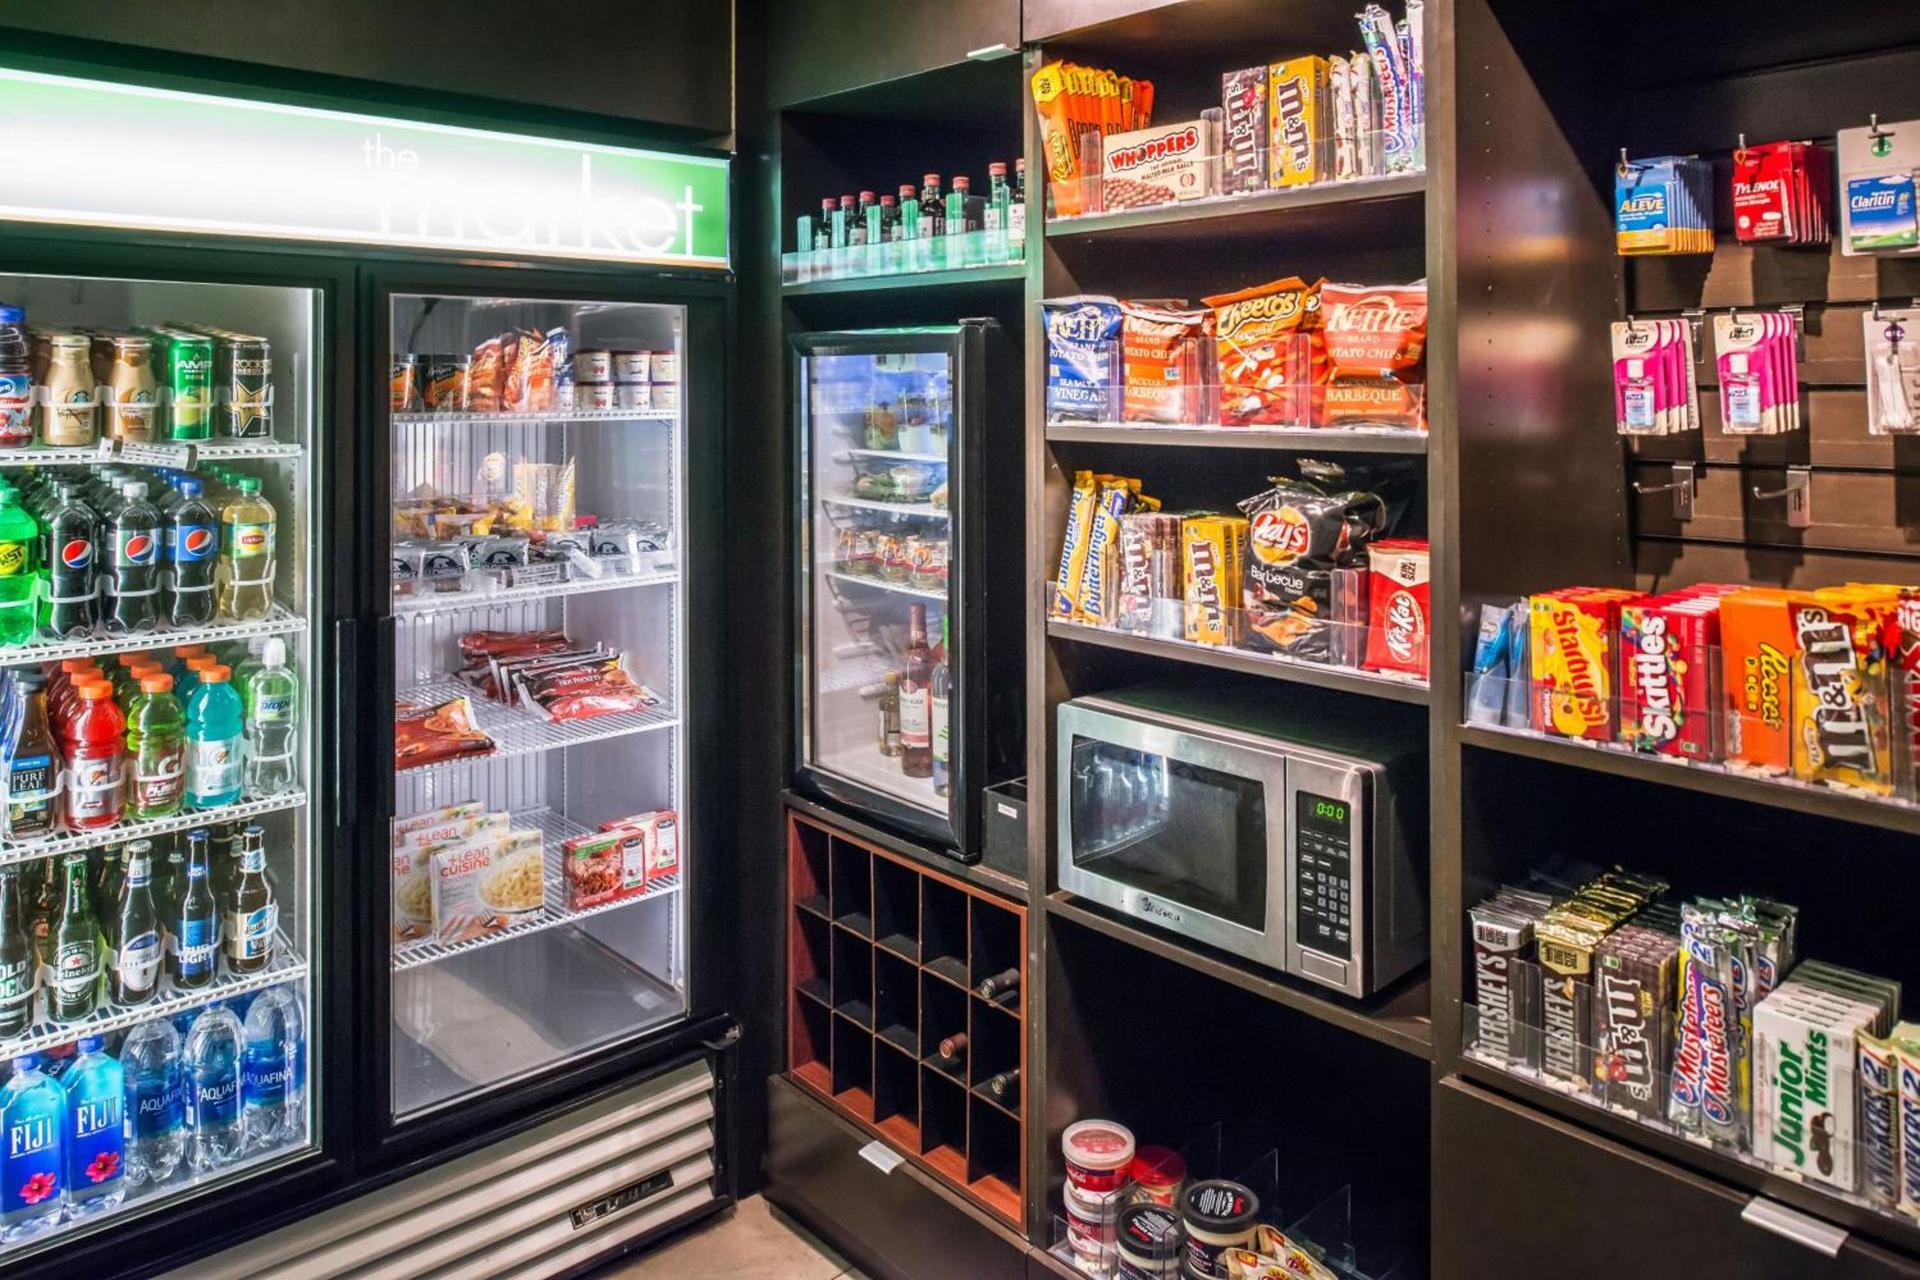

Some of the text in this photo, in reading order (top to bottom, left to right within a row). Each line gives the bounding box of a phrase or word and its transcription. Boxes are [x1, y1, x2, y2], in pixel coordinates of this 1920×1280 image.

[1227, 81, 1257, 174] m&m's
[1278, 76, 1310, 172] m&m's
[363, 133, 418, 170] the
[1111, 131, 1196, 169] WHOPPERS
[378, 153, 703, 258] market
[1620, 200, 1664, 212] ALEVE
[1735, 180, 1781, 195] TYLENOL
[1852, 194, 1895, 208] Claritin
[1217, 291, 1298, 336] Cheetos
[177, 361, 212, 369] AMP
[1367, 348, 1402, 361] CHIPS
[1056, 387, 1108, 402] VINEGAR
[1327, 388, 1402, 404] BARBEQUE
[1058, 490, 1083, 588] Butterfinger
[1085, 512, 1107, 616] Butterfinger
[1251, 565, 1304, 590] Barbecue
[1191, 541, 1221, 632] m&m's
[1636, 616, 1677, 740] Skittles
[1760, 643, 1788, 731] Reese's
[1800, 609, 1877, 773] m&m's
[12, 771, 46, 784] PURE
[13, 781, 42, 792] LEAF
[1316, 802, 1345, 820] 0:00
[425, 827, 457, 846] Lean
[457, 846, 491, 863] Lean
[439, 857, 491, 878] cuisine
[1478, 951, 1509, 1060] HERSHEY'S
[1543, 977, 1574, 1073] HERSHEY'S
[1605, 977, 1648, 1100] m&m's
[1703, 984, 1731, 1102] Musketeers
[1804, 1030, 1828, 1107] Mints
[76, 1097, 118, 1134] FIJI
[1772, 1041, 1805, 1166] Junior
[11, 1118, 53, 1155] FIJI
[1864, 1087, 1893, 1197] SNICKERS
